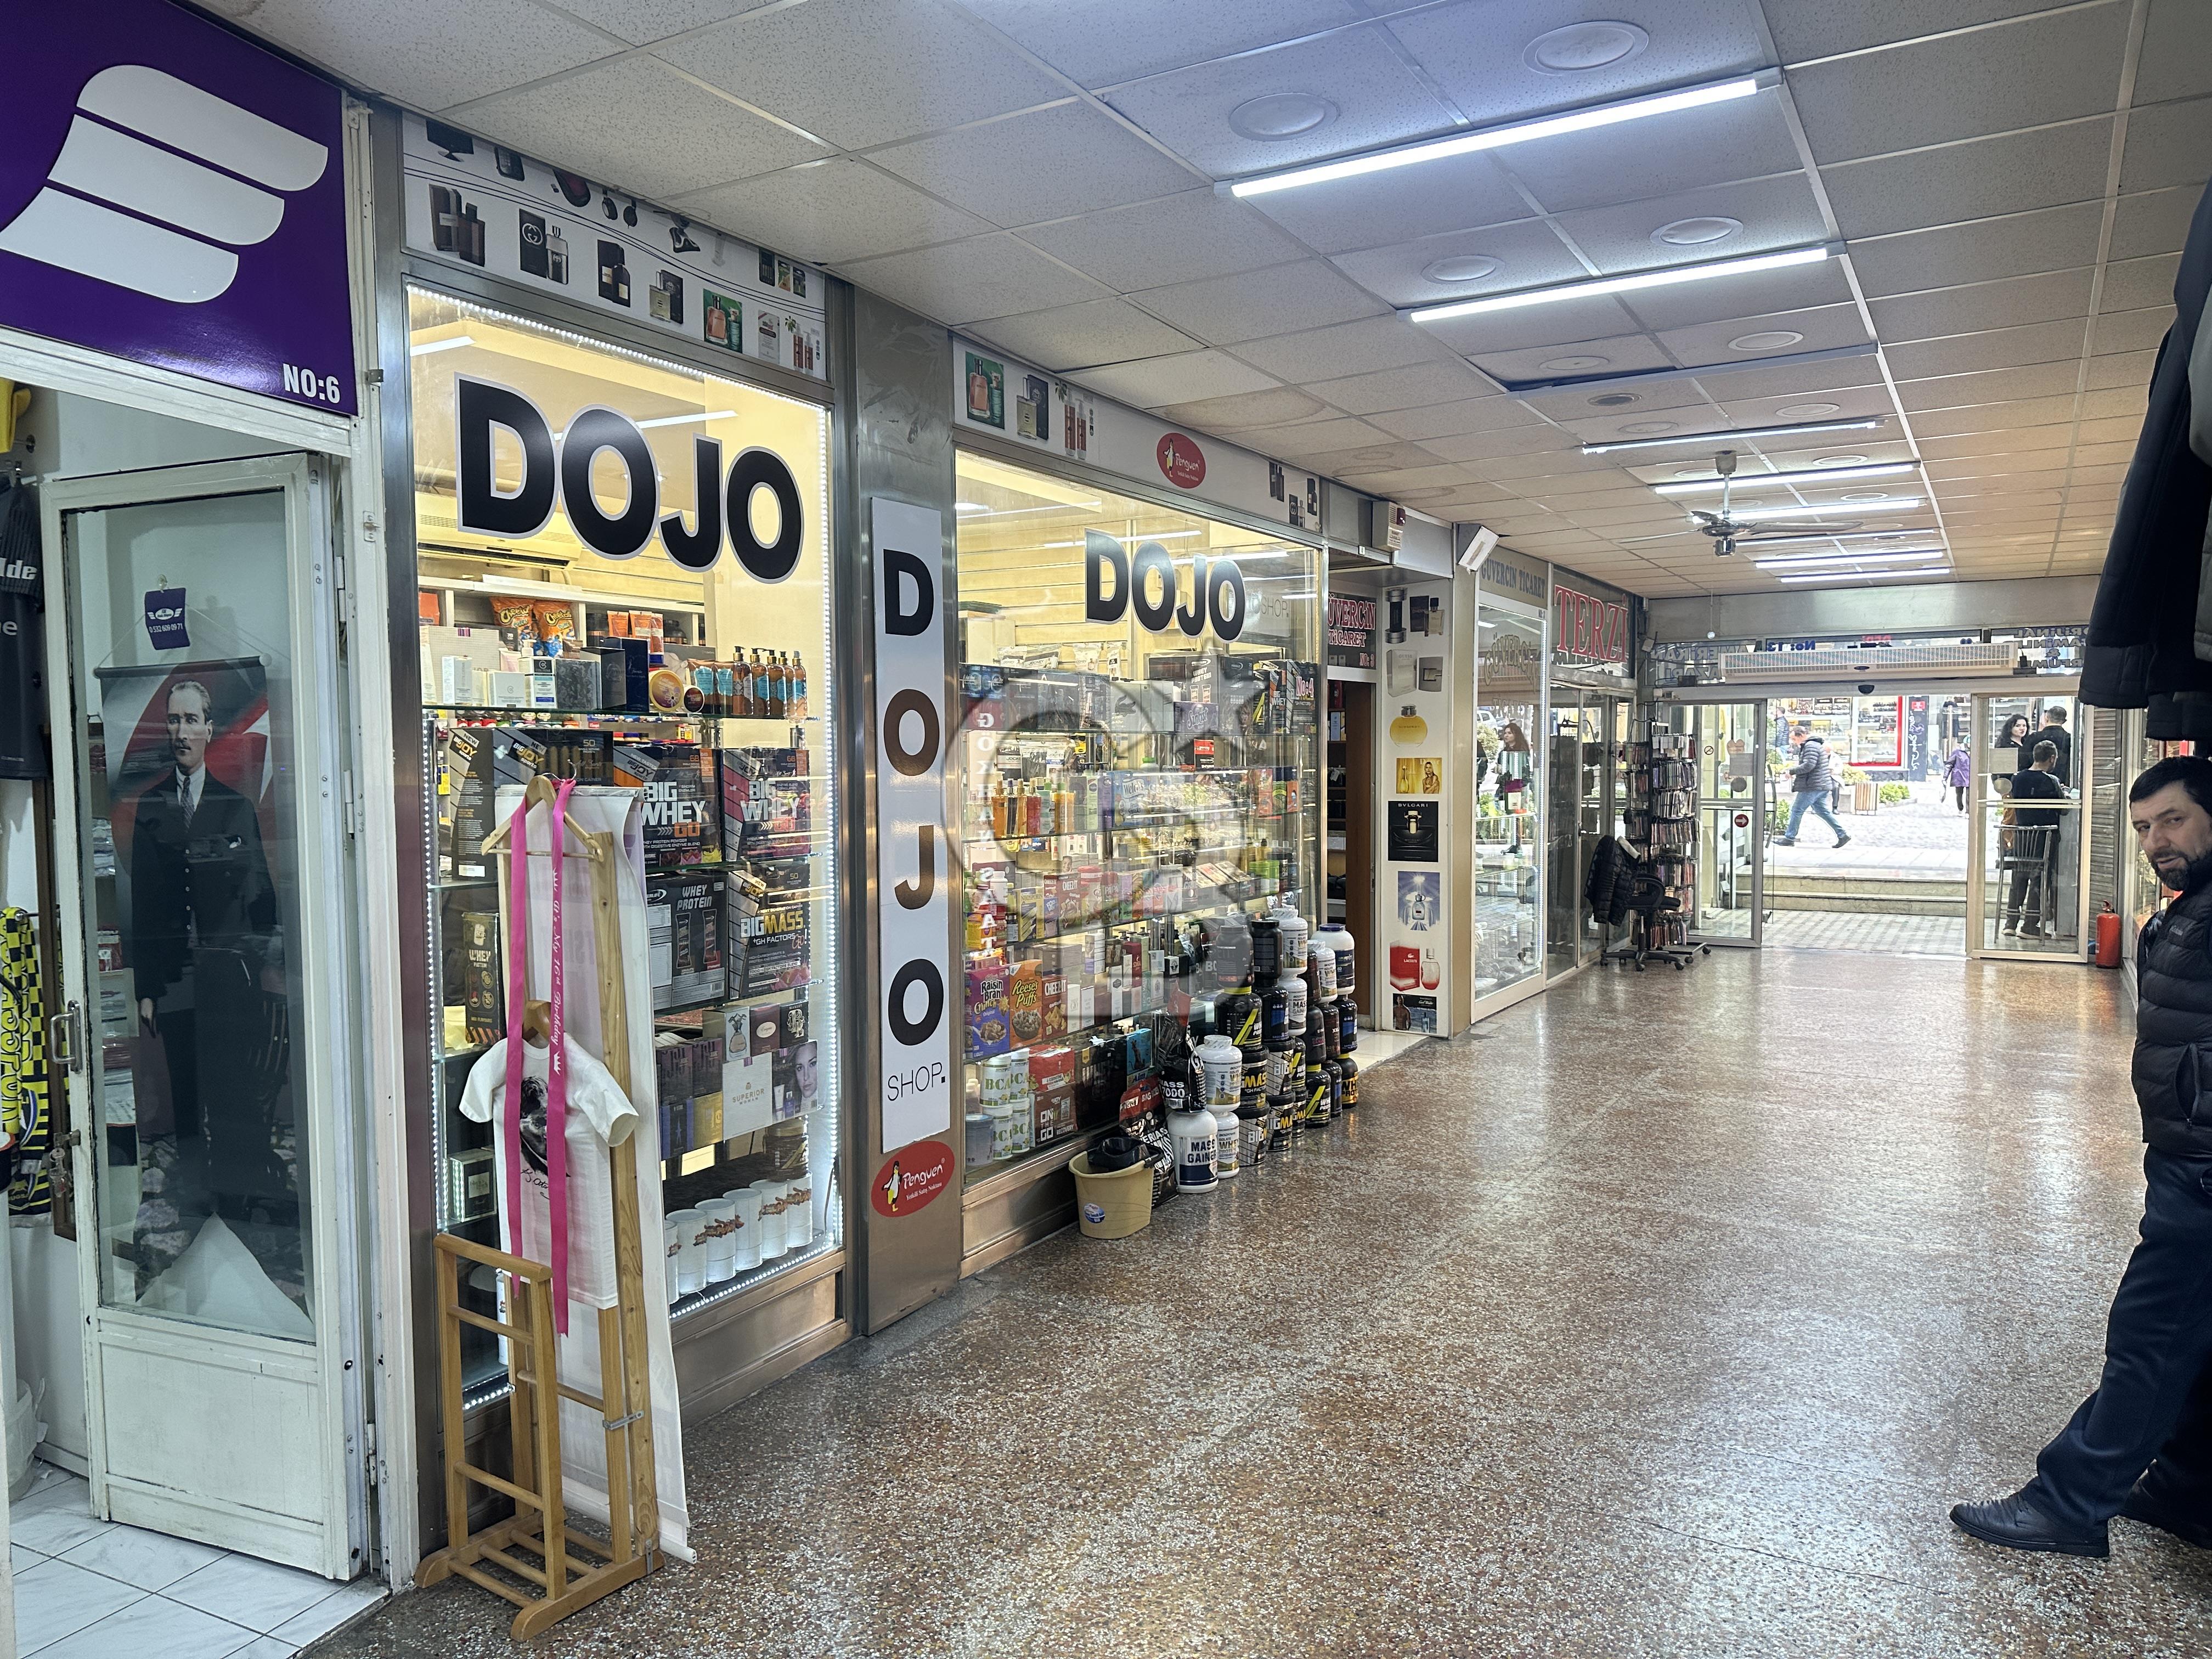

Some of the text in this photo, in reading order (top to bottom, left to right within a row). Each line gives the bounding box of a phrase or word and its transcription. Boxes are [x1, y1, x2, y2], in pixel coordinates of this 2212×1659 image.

[283, 363, 340, 404] NO:6
[1175, 453, 1199, 471] Penguen
[454, 371, 804, 584] DOJO
[1085, 529, 1246, 644] DOJO
[153, 625, 162, 633] 532
[1554, 584, 1629, 664] TERZİ
[644, 781, 678, 802] BIG
[641, 800, 706, 826] WHEY
[674, 821, 700, 838] GO
[682, 884, 707, 898] WHEY
[676, 896, 713, 911] PROTEIN
[766, 933, 795, 944] FACTORS
[469, 949, 491, 962] WHEY
[980, 980, 1003, 994] Raisin
[983, 989, 1002, 1002] Bran
[1016, 991, 1037, 1008] Puffs
[550, 991, 561, 1046] Birthday
[888, 1062, 946, 1102] SHOP.
[732, 1088, 765, 1103] SUPERIOR
[1040, 1108, 1054, 1124] ON
[1040, 1126, 1054, 1142] GO
[1191, 1138, 1216, 1152] MASS
[902, 1164, 944, 1189] Penguen
